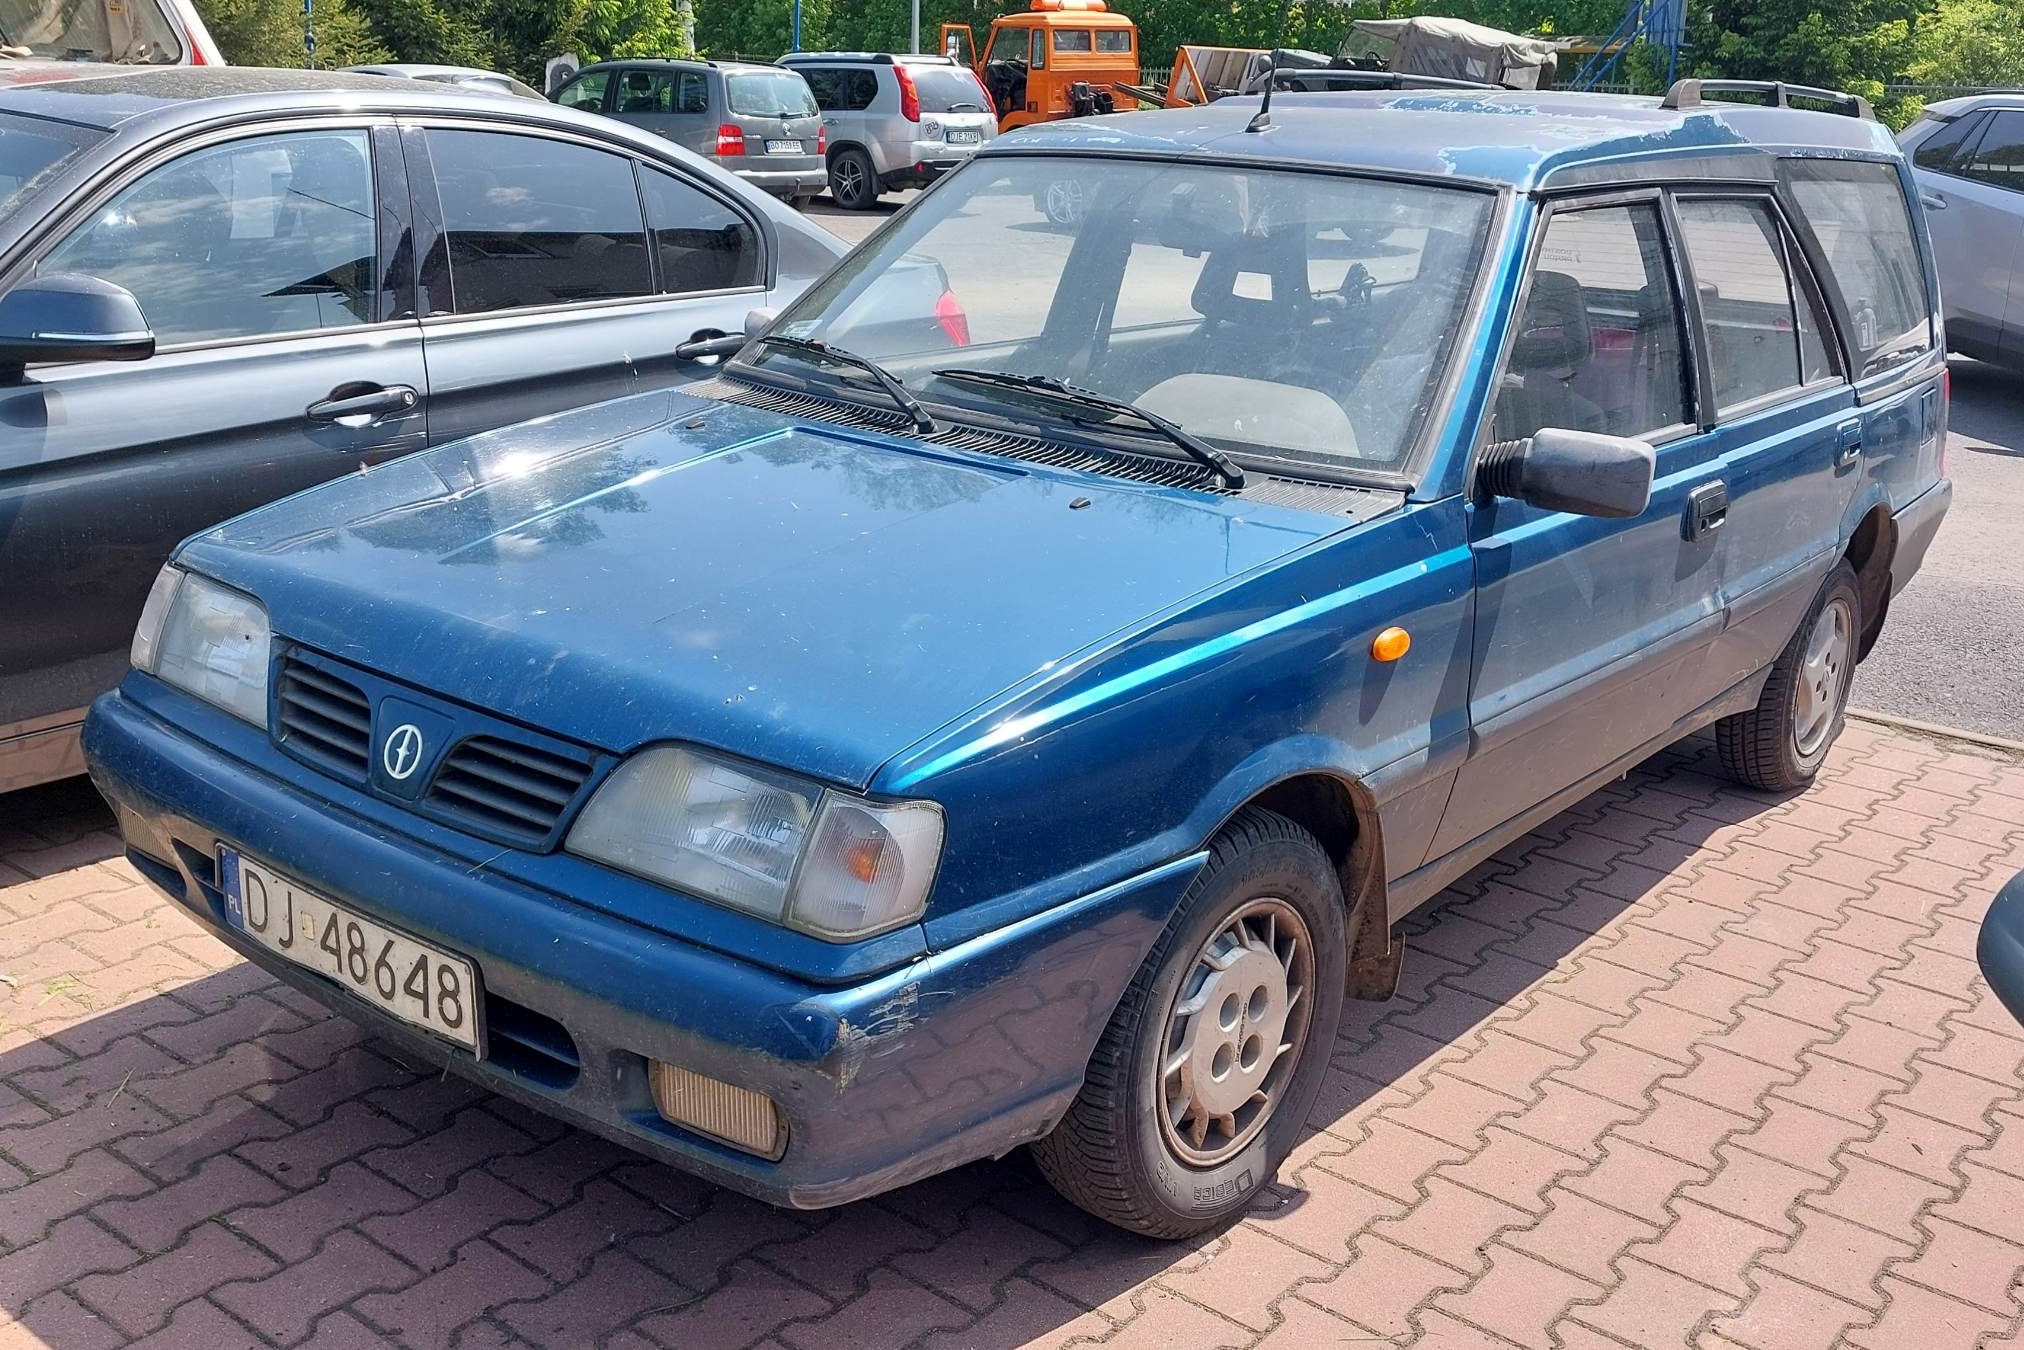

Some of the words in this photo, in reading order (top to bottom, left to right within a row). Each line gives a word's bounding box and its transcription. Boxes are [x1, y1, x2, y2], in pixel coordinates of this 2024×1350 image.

[228, 894, 241, 914] PL
[245, 868, 294, 949] DJ
[320, 912, 463, 1029] 48648
